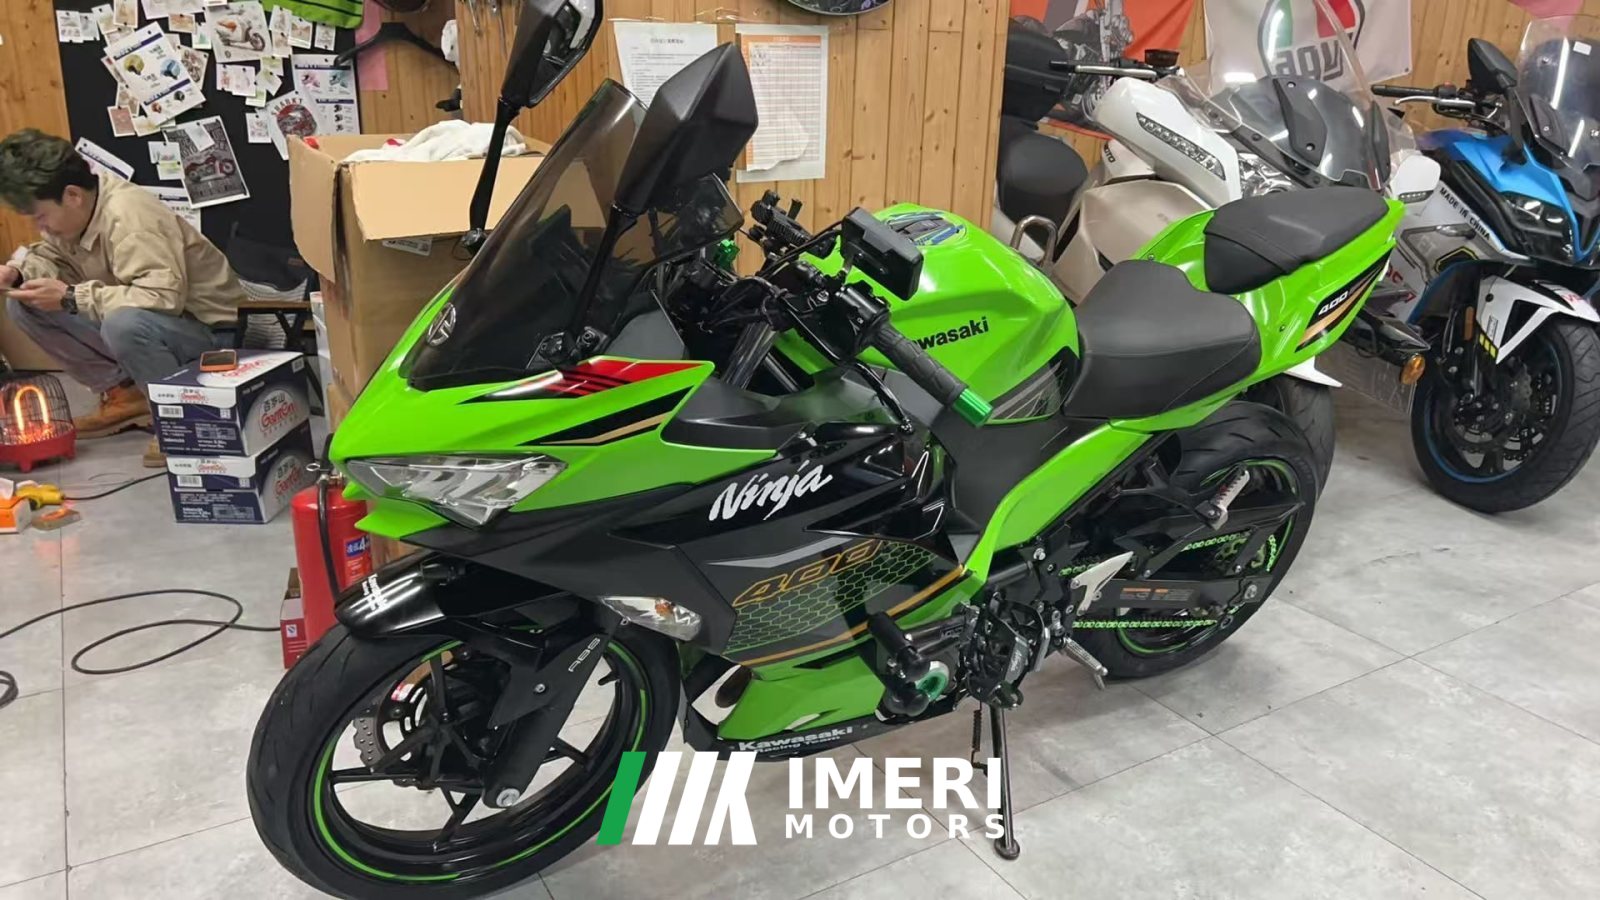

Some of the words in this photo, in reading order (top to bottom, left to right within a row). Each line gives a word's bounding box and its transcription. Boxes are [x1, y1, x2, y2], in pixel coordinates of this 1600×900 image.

[1439, 187, 1458, 208] MADE
[1469, 217, 1491, 241] CHINA
[1318, 290, 1349, 316] 400
[912, 315, 989, 350] wasaki
[708, 459, 834, 521] Ninja
[732, 538, 882, 608] 400
[567, 637, 601, 673] ABS
[738, 726, 853, 752] Kawasaki
